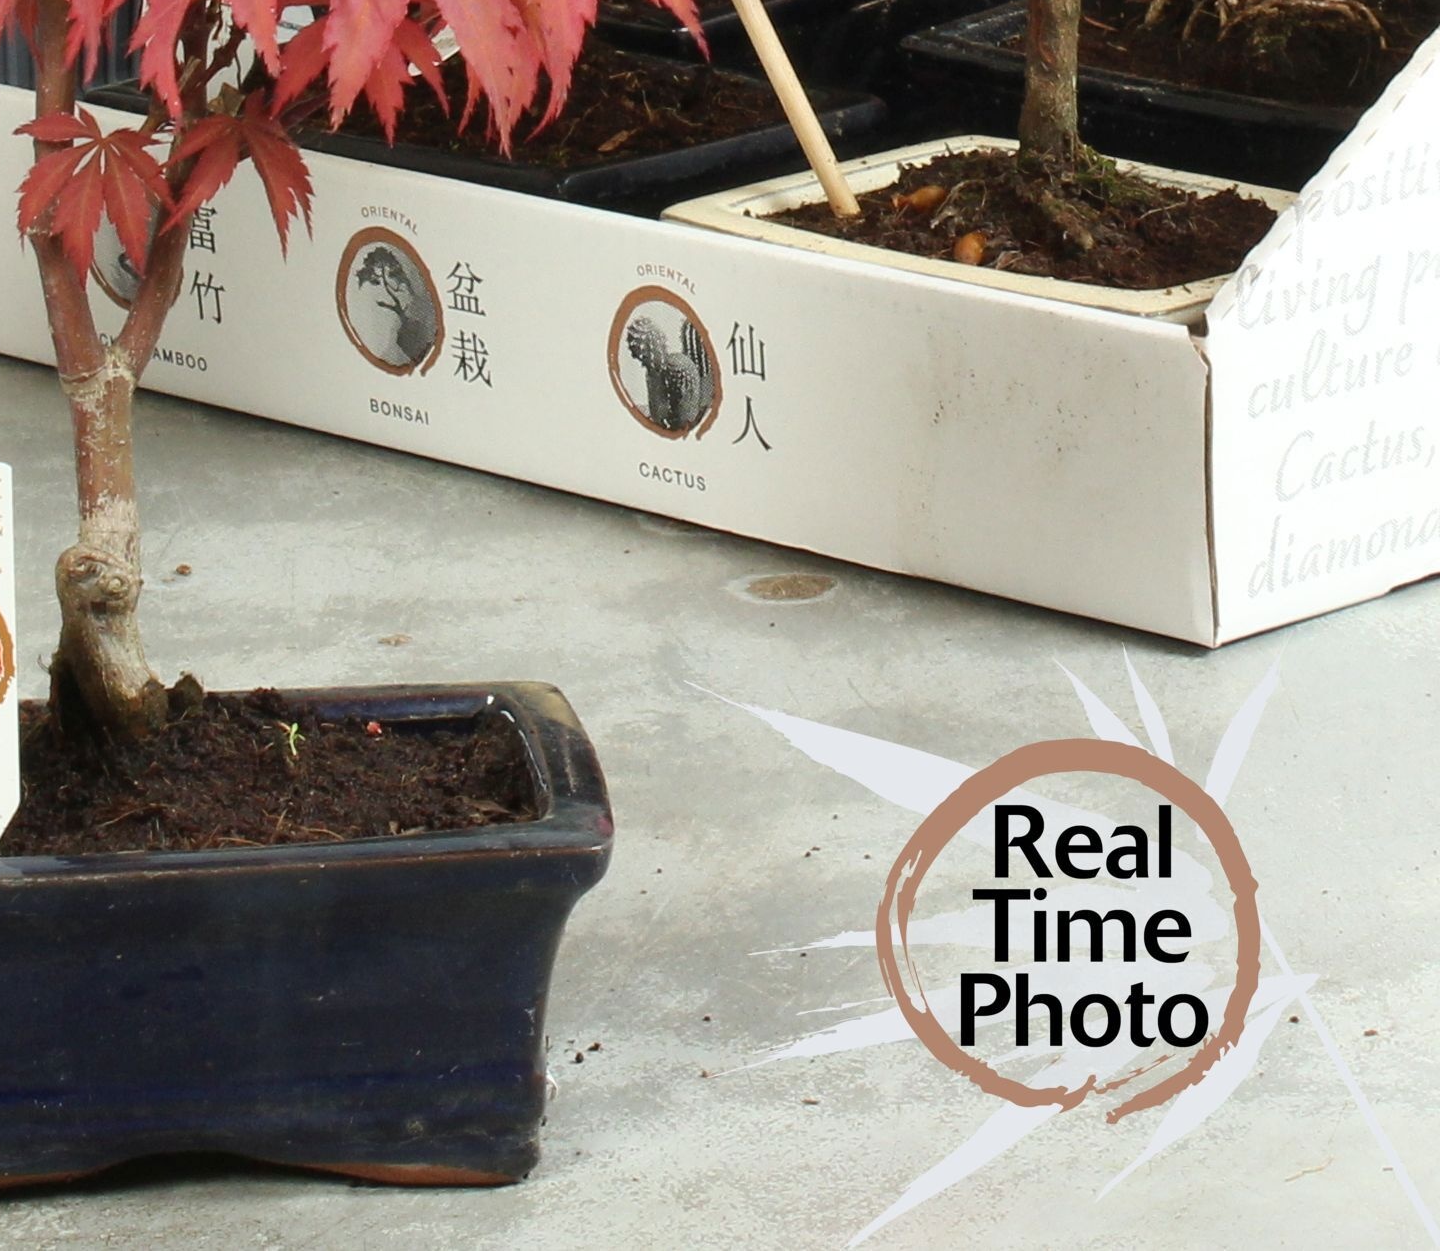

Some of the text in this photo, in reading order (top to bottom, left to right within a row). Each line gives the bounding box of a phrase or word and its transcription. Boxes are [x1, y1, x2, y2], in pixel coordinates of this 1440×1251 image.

[361, 205, 419, 236] ORIENTAL
[1295, 141, 1440, 264] positi
[636, 263, 698, 296] ORIENTAL
[1232, 253, 1382, 337] living
[446, 260, 493, 389] 盆栽
[152, 347, 208, 372] AMBOO
[726, 321, 772, 452] 仙人
[1247, 328, 1414, 419] culture
[368, 398, 430, 426] BONSAI
[638, 461, 707, 492] CACTUS
